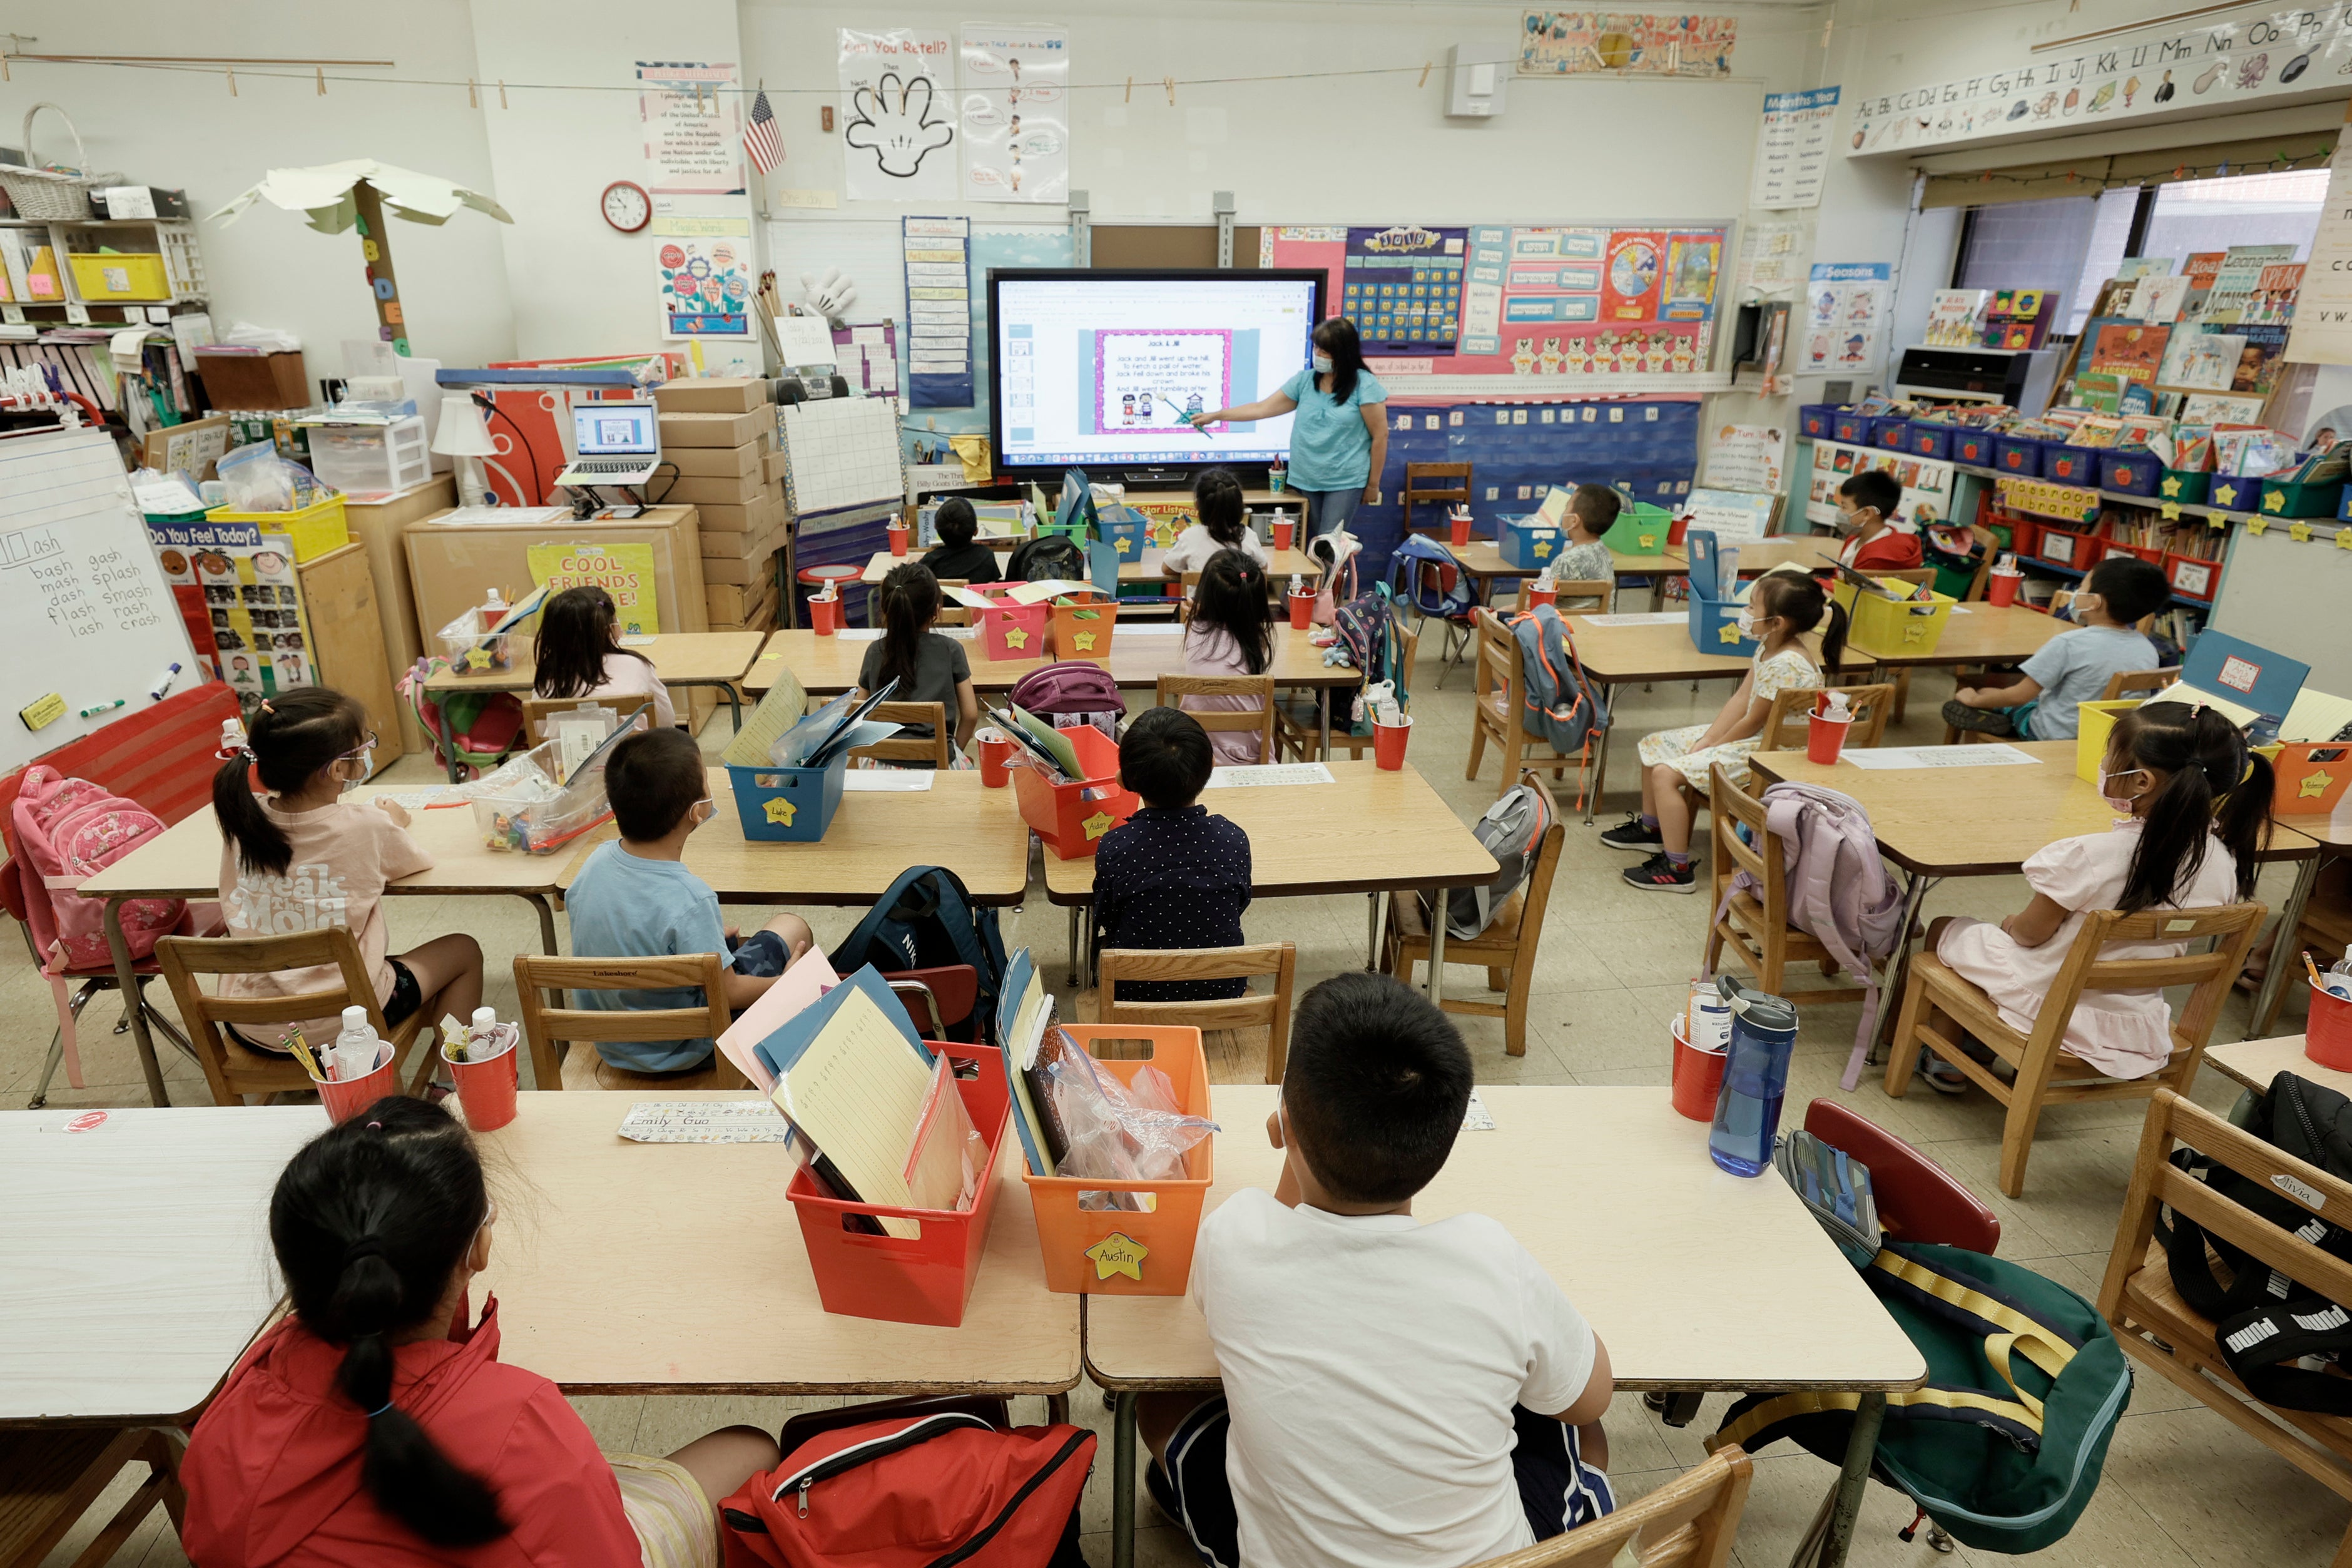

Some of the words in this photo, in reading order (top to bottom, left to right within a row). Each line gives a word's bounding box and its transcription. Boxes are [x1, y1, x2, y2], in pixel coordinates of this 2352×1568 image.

[873, 40, 897, 54] You
[904, 40, 947, 54] Retell?
[1858, 102, 1872, 120] Aa
[1879, 98, 1891, 115] Bb
[1898, 93, 1912, 110] Cc
[1918, 87, 1936, 106] Dd
[1943, 84, 1958, 103] Ee
[1965, 79, 1982, 99] Ff
[1989, 74, 2010, 97] Gg
[2017, 68, 2034, 88] Hh
[2045, 63, 2060, 84] Ii
[2070, 58, 2085, 84] Jj
[2096, 51, 2118, 74] Kk
[2131, 45, 2147, 68] Ll
[2159, 38, 2191, 63] Mm
[2204, 31, 2232, 54] Nn
[2248, 21, 2279, 45] Oo
[2296, 12, 2323, 43] Pp
[1767, 96, 1811, 108] Months
[1816, 92, 1836, 103] Year
[669, 221, 696, 234] Magic
[700, 221, 726, 232] Words
[1380, 232, 1427, 247] July
[1826, 266, 1875, 278] Seasons
[2258, 265, 2301, 288] SPEAK
[2090, 365, 2151, 381] CLASSMATES
[1998, 479, 2095, 506] Classroom
[1141, 506, 1161, 514] Star
[1164, 505, 1199, 516] Listener
[2008, 494, 2083, 517] Library
[33, 529, 61, 556] ash
[150, 529, 166, 544] Do
[166, 528, 188, 544] You
[189, 527, 216, 544] Feel
[215, 527, 258, 549] Today?
[29, 557, 74, 581] bash
[89, 548, 123, 572] gash
[561, 557, 623, 572] COOL
[41, 576, 79, 594] mash
[92, 563, 141, 591] splash
[548, 573, 639, 589] FRIENDS
[50, 587, 86, 607] dash
[102, 584, 153, 604] smash
[48, 602, 97, 626] flash
[112, 601, 150, 619] rash
[69, 619, 105, 638] lash
[121, 611, 161, 631] crash
[772, 807, 787, 817] Luke
[1089, 822, 1106, 831] Aidan
[228, 895, 345, 935] Mold
[271, 897, 304, 911] The
[631, 1115, 672, 1128] Emily
[683, 1116, 710, 1125] Guo
[2274, 1175, 2311, 1203] Olivia
[1099, 1247, 1136, 1269] Austin
[2225, 1317, 2281, 1353] PUMA
